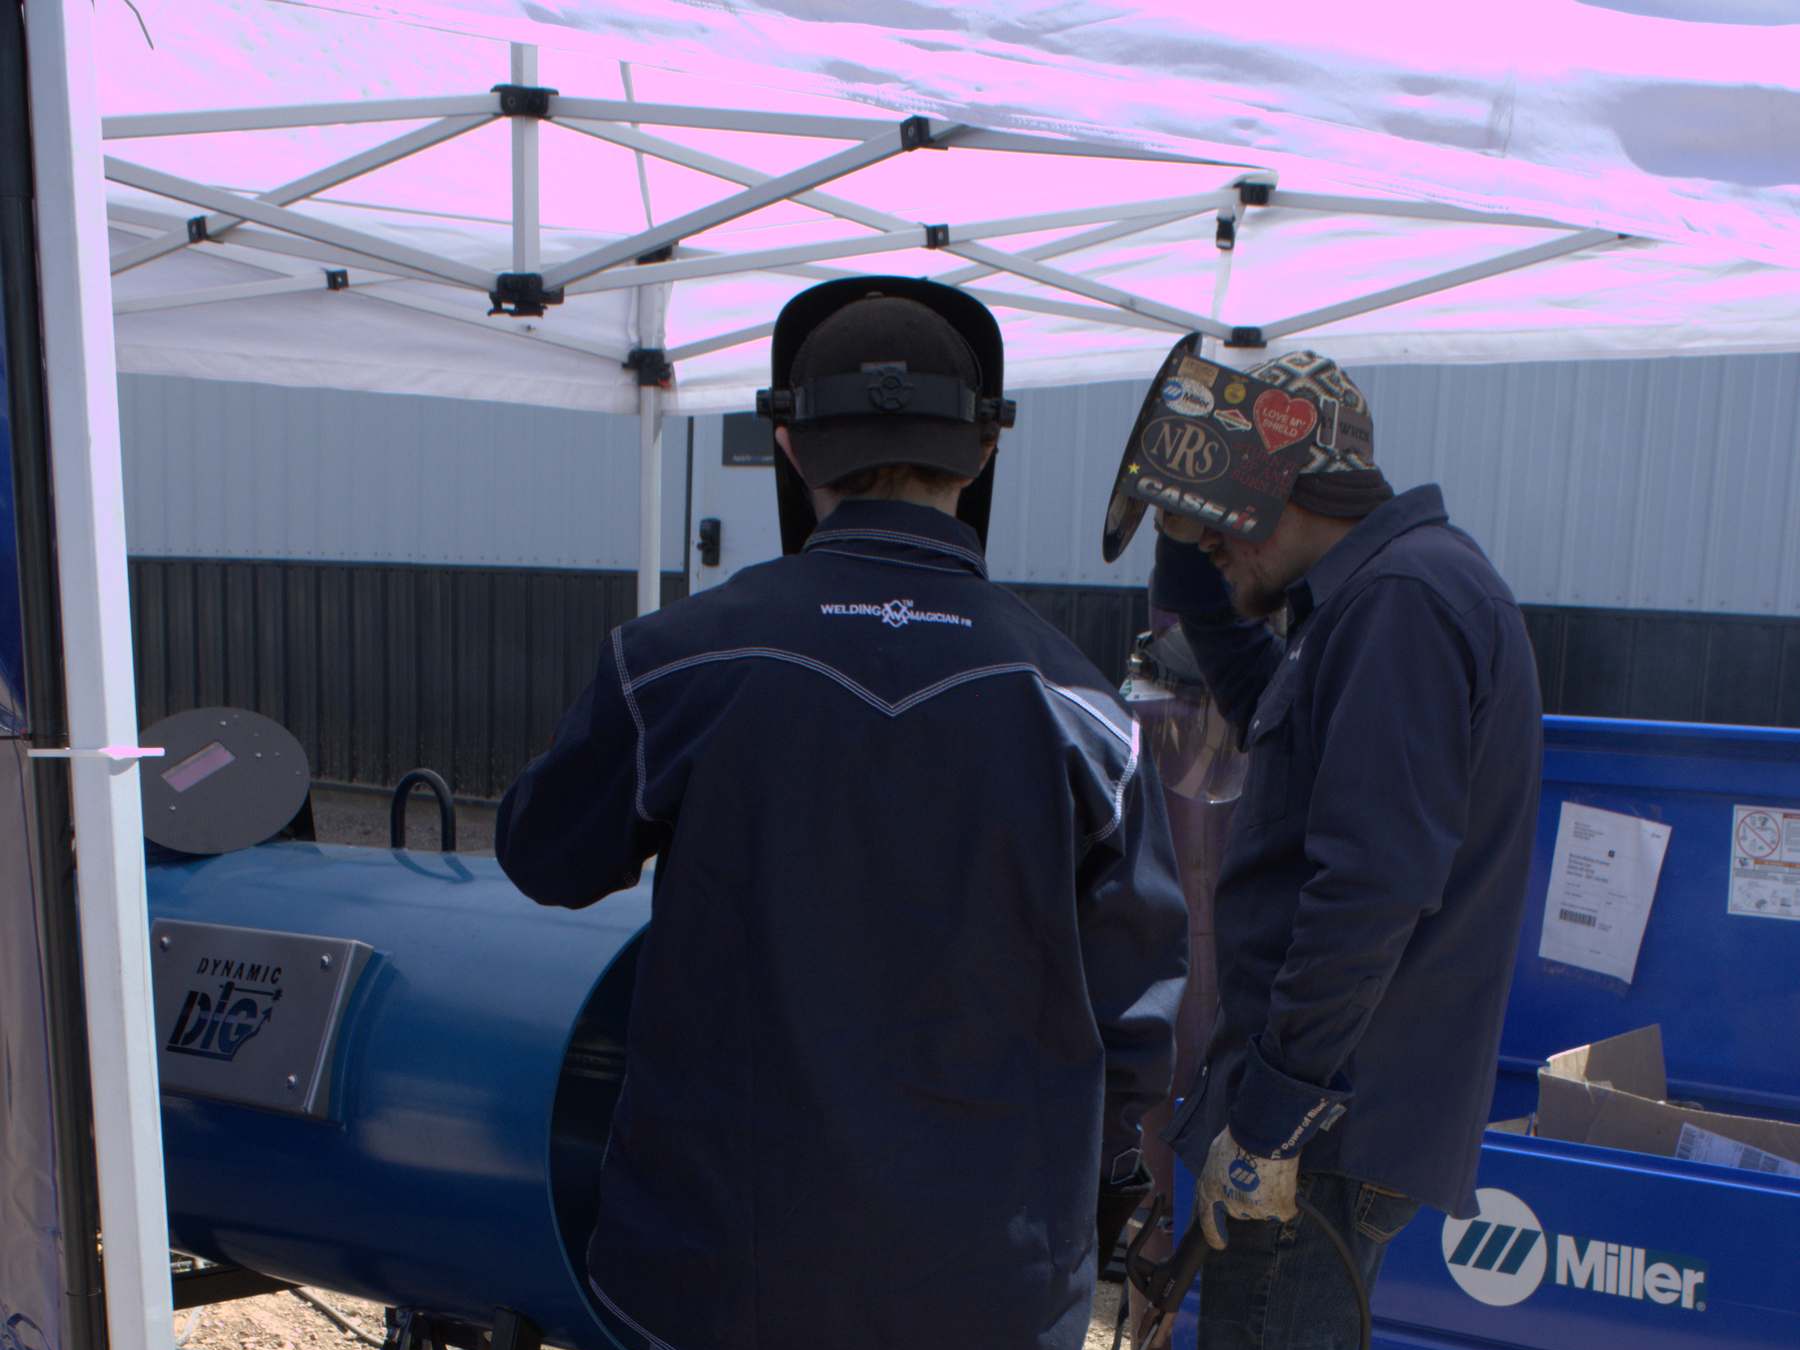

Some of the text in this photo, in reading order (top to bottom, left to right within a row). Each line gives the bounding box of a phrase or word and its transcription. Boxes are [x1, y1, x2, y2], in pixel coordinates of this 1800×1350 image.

[1262, 408, 1288, 424] LOVE
[1290, 417, 1306, 428] MY
[1263, 418, 1297, 437] SHIELD
[1151, 421, 1219, 478] NRS
[820, 604, 881, 616] WELDING
[196, 957, 282, 984] DYNAMIC
[1555, 1234, 1704, 1310] Miller
